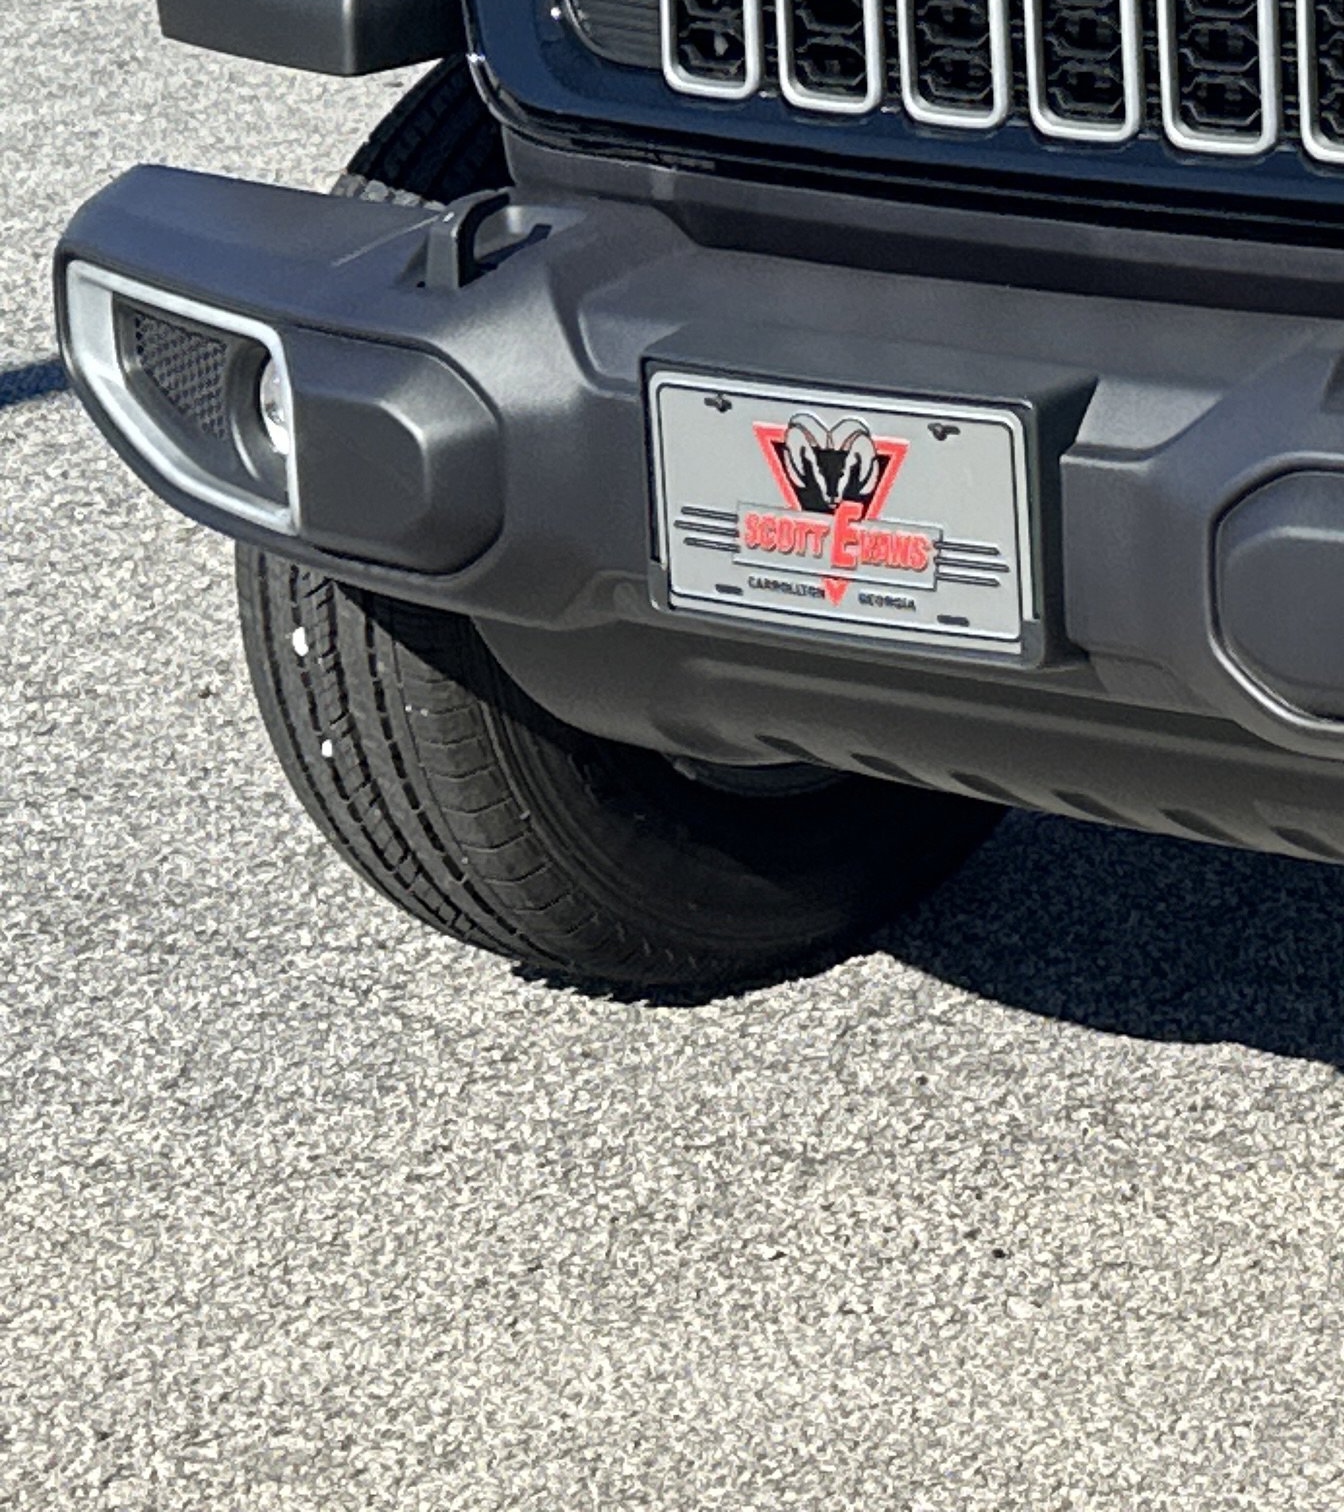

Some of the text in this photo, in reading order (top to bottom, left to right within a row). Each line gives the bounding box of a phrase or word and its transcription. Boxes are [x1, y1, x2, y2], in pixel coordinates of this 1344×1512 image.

[744, 500, 931, 572] SCOTT EVANS
[747, 575, 917, 613] CARROLLTON GEORGIA
